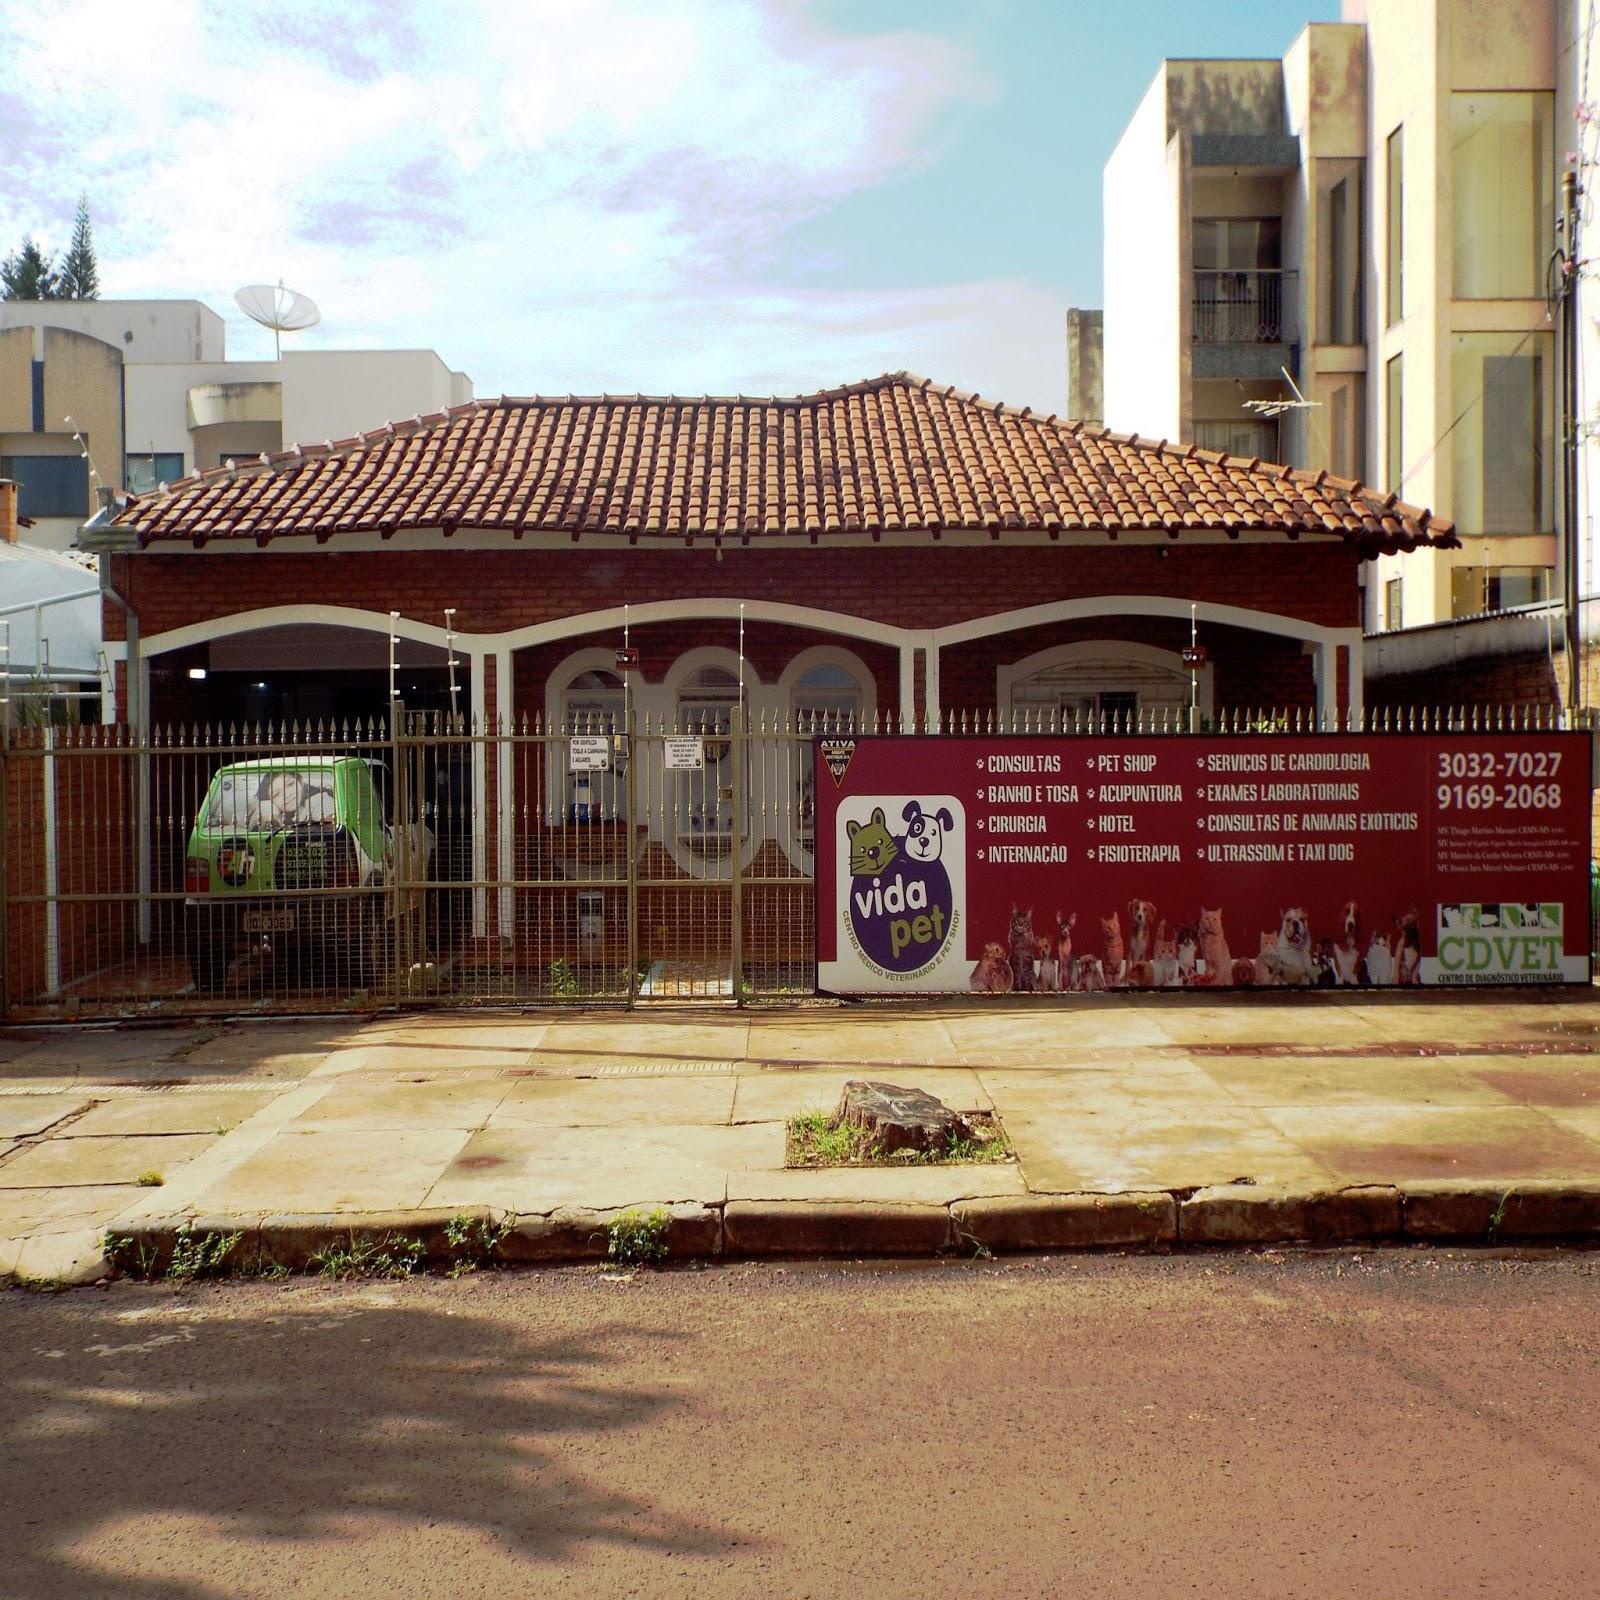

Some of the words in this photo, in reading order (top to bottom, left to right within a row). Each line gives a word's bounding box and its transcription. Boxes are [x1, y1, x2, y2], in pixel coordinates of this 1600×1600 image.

[821, 740, 856, 750] ATIVA
[988, 755, 1061, 772] CONSULTAS
[1099, 755, 1121, 771] PET
[1124, 754, 1156, 772] SHOP
[1208, 754, 1267, 773] SERVIÇOS
[1271, 754, 1286, 771] DE
[1289, 753, 1370, 771] CARDIOLOGIA
[1438, 752, 1562, 778] 3032-7027
[988, 785, 1032, 802] BANHO
[1036, 785, 1042, 802] E
[1046, 785, 1078, 802] TOSA
[1099, 785, 1182, 802] ACUPUNTURA
[1208, 784, 1257, 801] EXAMES
[1261, 783, 1360, 801] LABORATORIAIS
[1437, 784, 1562, 810] 9169-2068
[988, 815, 1047, 833] CIRURGIA
[1099, 815, 1135, 832] HOTEL
[1208, 814, 1280, 831] CONSULTAS
[1284, 814, 1298, 831] DE
[1302, 813, 1356, 831] ANIMAIS
[1360, 811, 1418, 830] EXÓTICOS
[988, 842, 1068, 865] INTERNAÇÃO
[1099, 845, 1181, 863] FISIOTERAPIA
[1207, 844, 1284, 862] ULTRASSOM
[1288, 844, 1294, 861] E
[1298, 844, 1325, 861] TAXI
[1329, 843, 1354, 860] DOG
[855, 873, 927, 918] vida
[842, 910, 860, 950] CENTRO
[937, 957, 943, 965] E
[941, 939, 953, 958] PET
[949, 910, 960, 939] SHOP
[890, 904, 945, 959] pet
[1439, 935, 1563, 971] CDVET
[1438, 973, 1465, 983] CENTRO
[1466, 974, 1475, 983] DE
[1476, 972, 1520, 983] DIAGNÓSTICO
[1521, 972, 1565, 983] VETERINÁRIO
